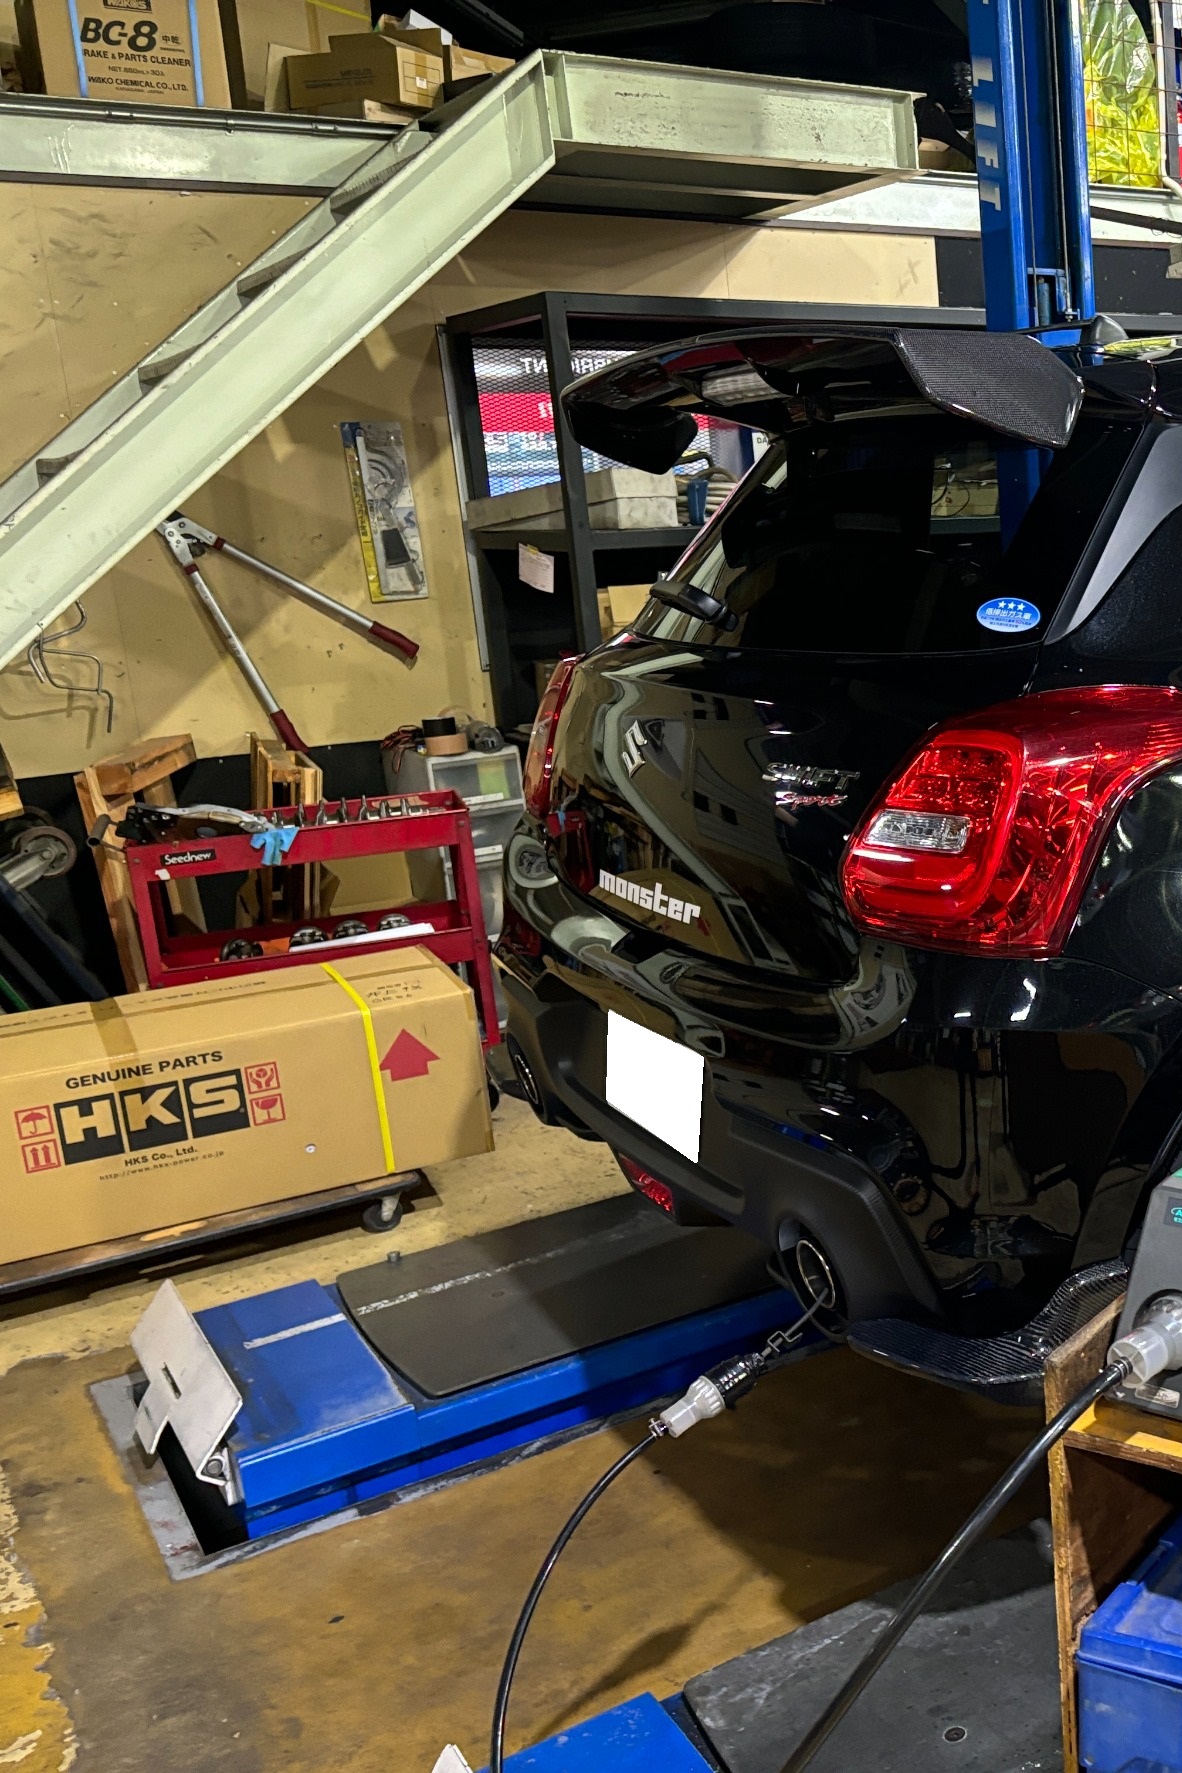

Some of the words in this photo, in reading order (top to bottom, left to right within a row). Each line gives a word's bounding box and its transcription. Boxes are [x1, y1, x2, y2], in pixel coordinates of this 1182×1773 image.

[80, 17, 158, 53] BC-8
[118, 52, 148, 63] PARTS
[150, 56, 192, 67] CLEANER
[115, 78, 155, 88] CHEMICAL
[164, 852, 212, 866] Seednew
[599, 868, 701, 925] monster
[65, 1063, 154, 1090] GENUINE
[158, 1050, 223, 1073] PARTS
[57, 1072, 243, 1147] HKS
[124, 1155, 149, 1168] HKS
[176, 1146, 198, 1157] Ltd.
